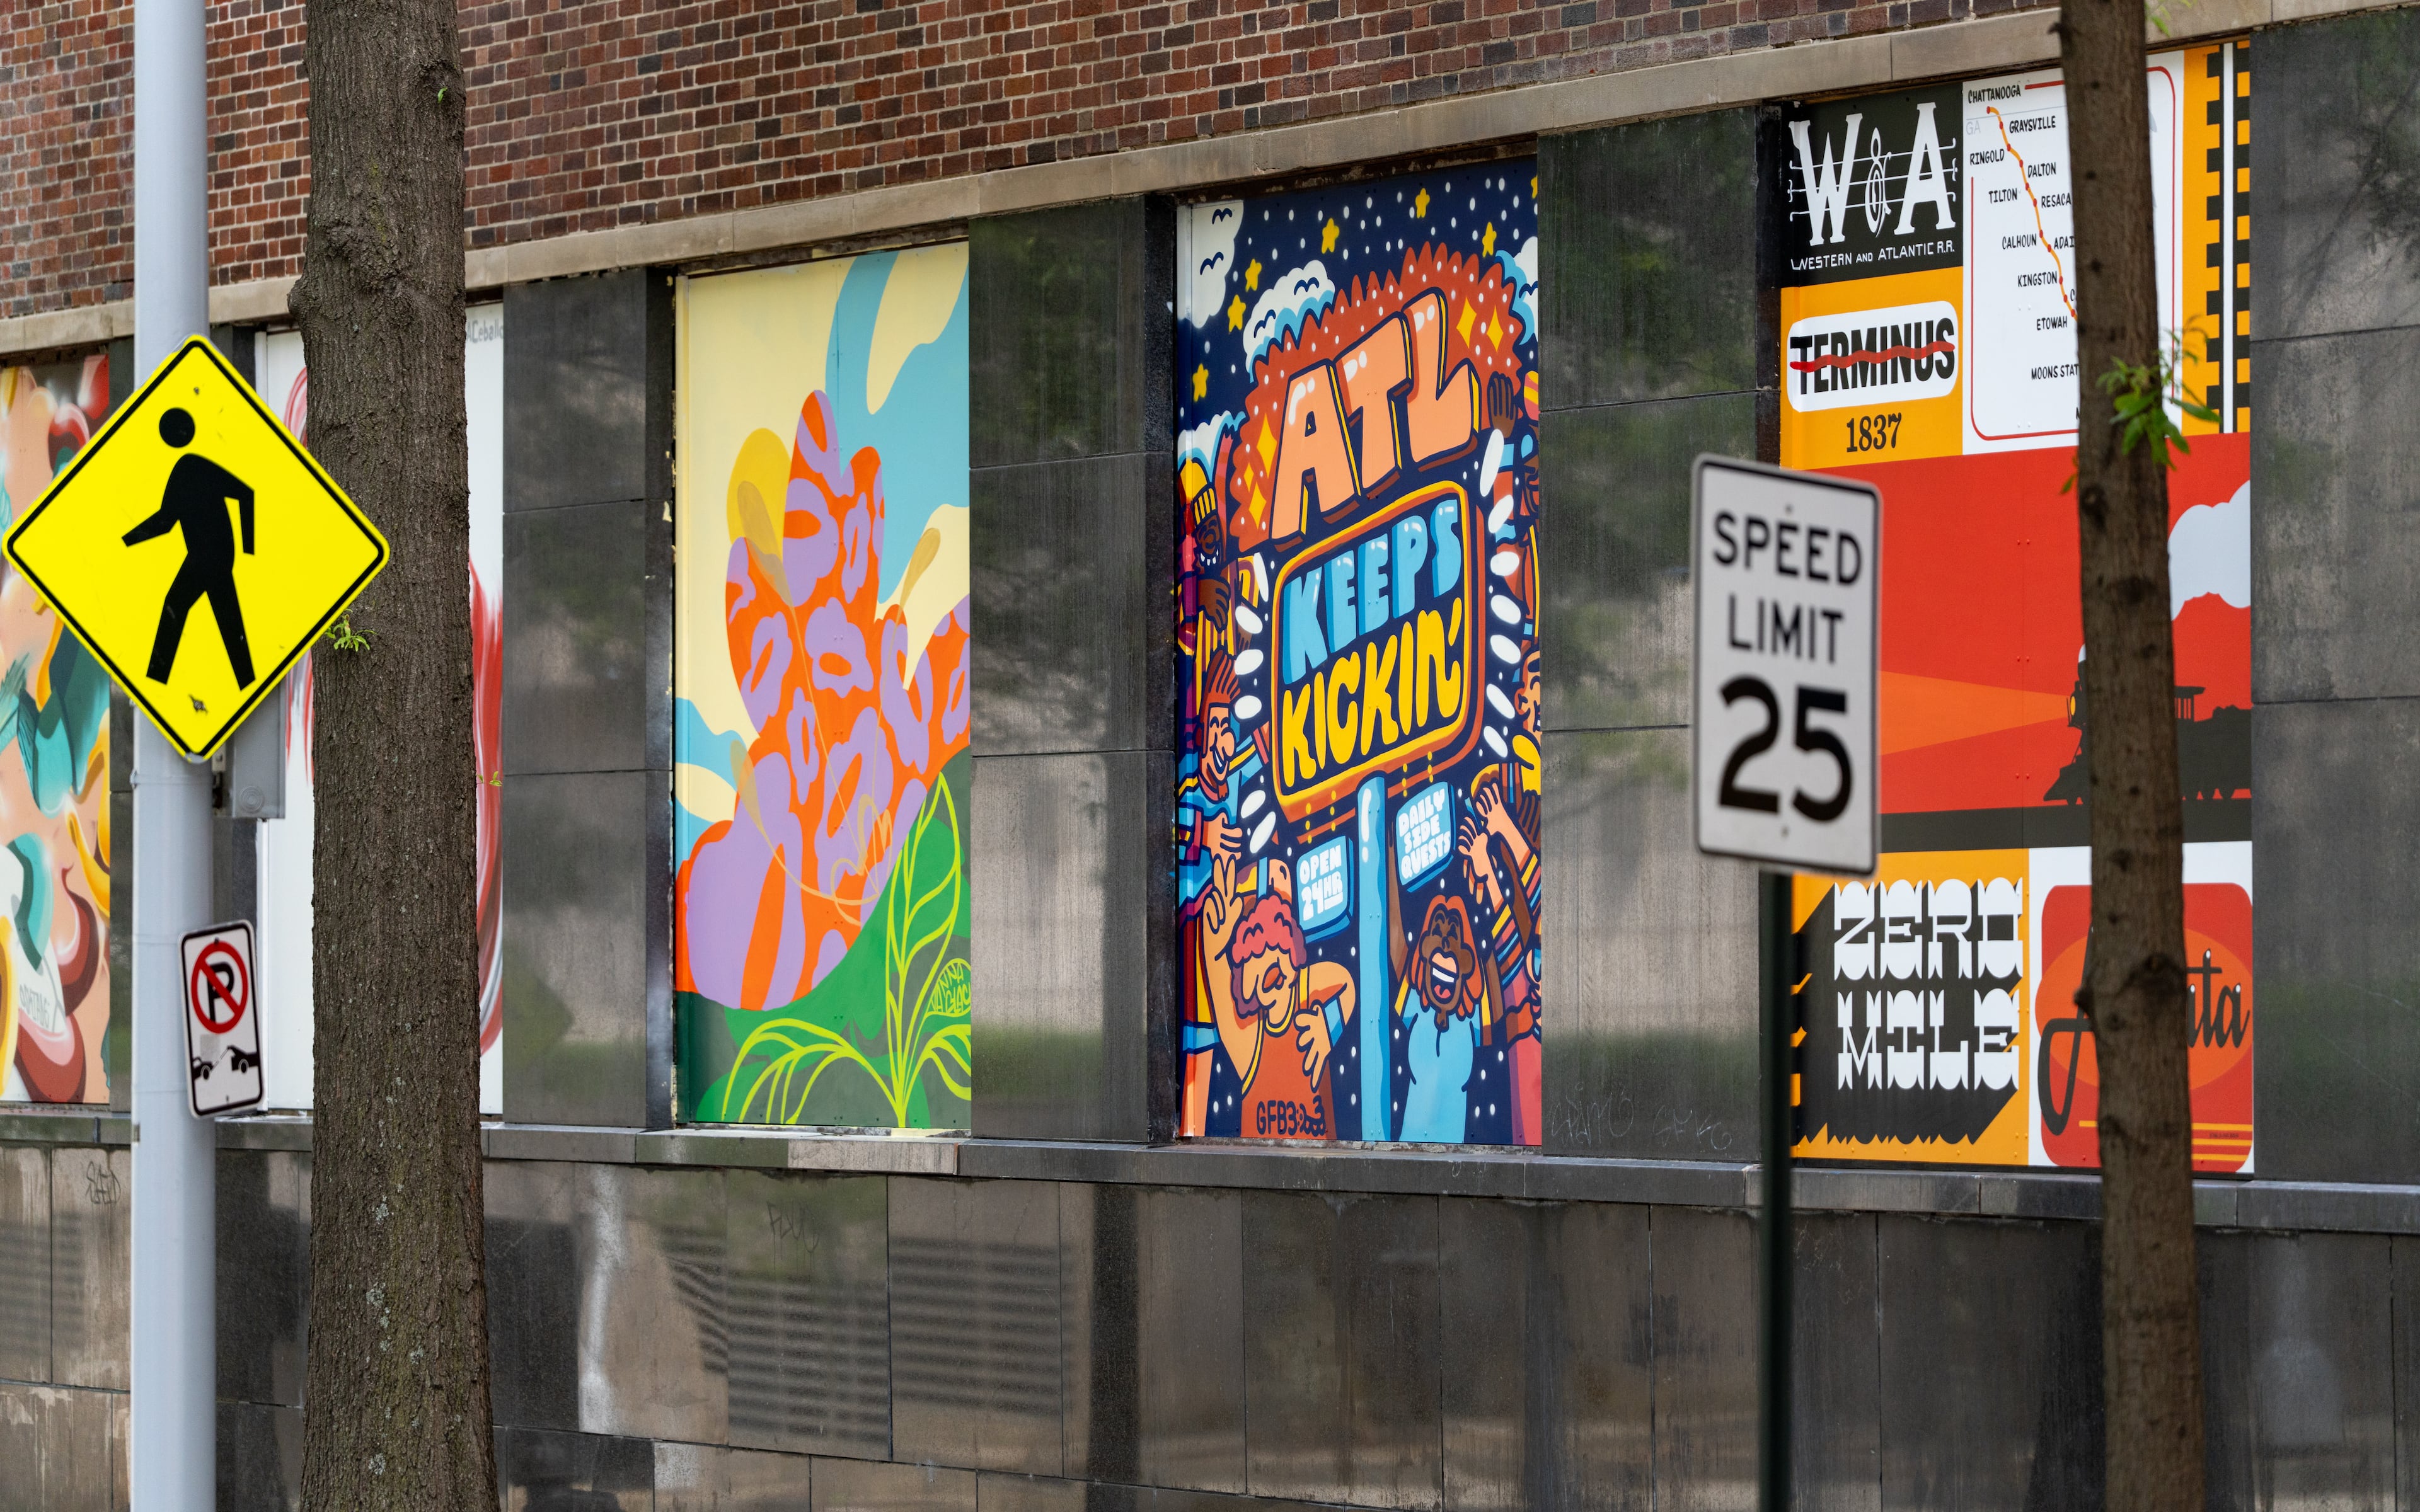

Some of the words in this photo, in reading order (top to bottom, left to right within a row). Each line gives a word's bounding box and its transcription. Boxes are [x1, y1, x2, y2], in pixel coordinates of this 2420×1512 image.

[1968, 84, 2021, 103] CHATTANOOGA
[1966, 120, 1981, 135] GA
[2009, 115, 2056, 134] GRAYSVILLE
[1970, 149, 2005, 165] RINGOLD
[2027, 162, 2056, 178] DALTON
[1988, 188, 2017, 203] TILTON
[2041, 192, 2072, 209] RESACA
[1790, 252, 1852, 271] WESTERN
[1855, 252, 1873, 263] AND
[1878, 242, 1934, 261] ATLANTIC
[1937, 239, 1955, 253] R.R.
[2002, 233, 2037, 249] CALHOUN
[2018, 271, 2058, 287] KINGSTON
[2036, 316, 2067, 331] ETOWAH
[1790, 318, 1955, 395] TERMINUS
[2031, 365, 2058, 381] MOONS
[2060, 364, 2080, 377] STAT
[1269, 287, 1482, 542] ATL
[1846, 412, 1903, 453] 1837
[1712, 510, 1863, 587] SPEED
[1282, 499, 1462, 685] KEEPS
[1727, 593, 1844, 666] LIMIT
[1717, 673, 1855, 824] 25
[1398, 788, 1446, 837] DAILY
[1403, 813, 1441, 854] SIDE
[1299, 844, 1342, 885] OPEN
[1400, 830, 1451, 879] QUESTS
[1834, 876, 2024, 982] ZERO
[1837, 988, 2020, 1091] MILE
